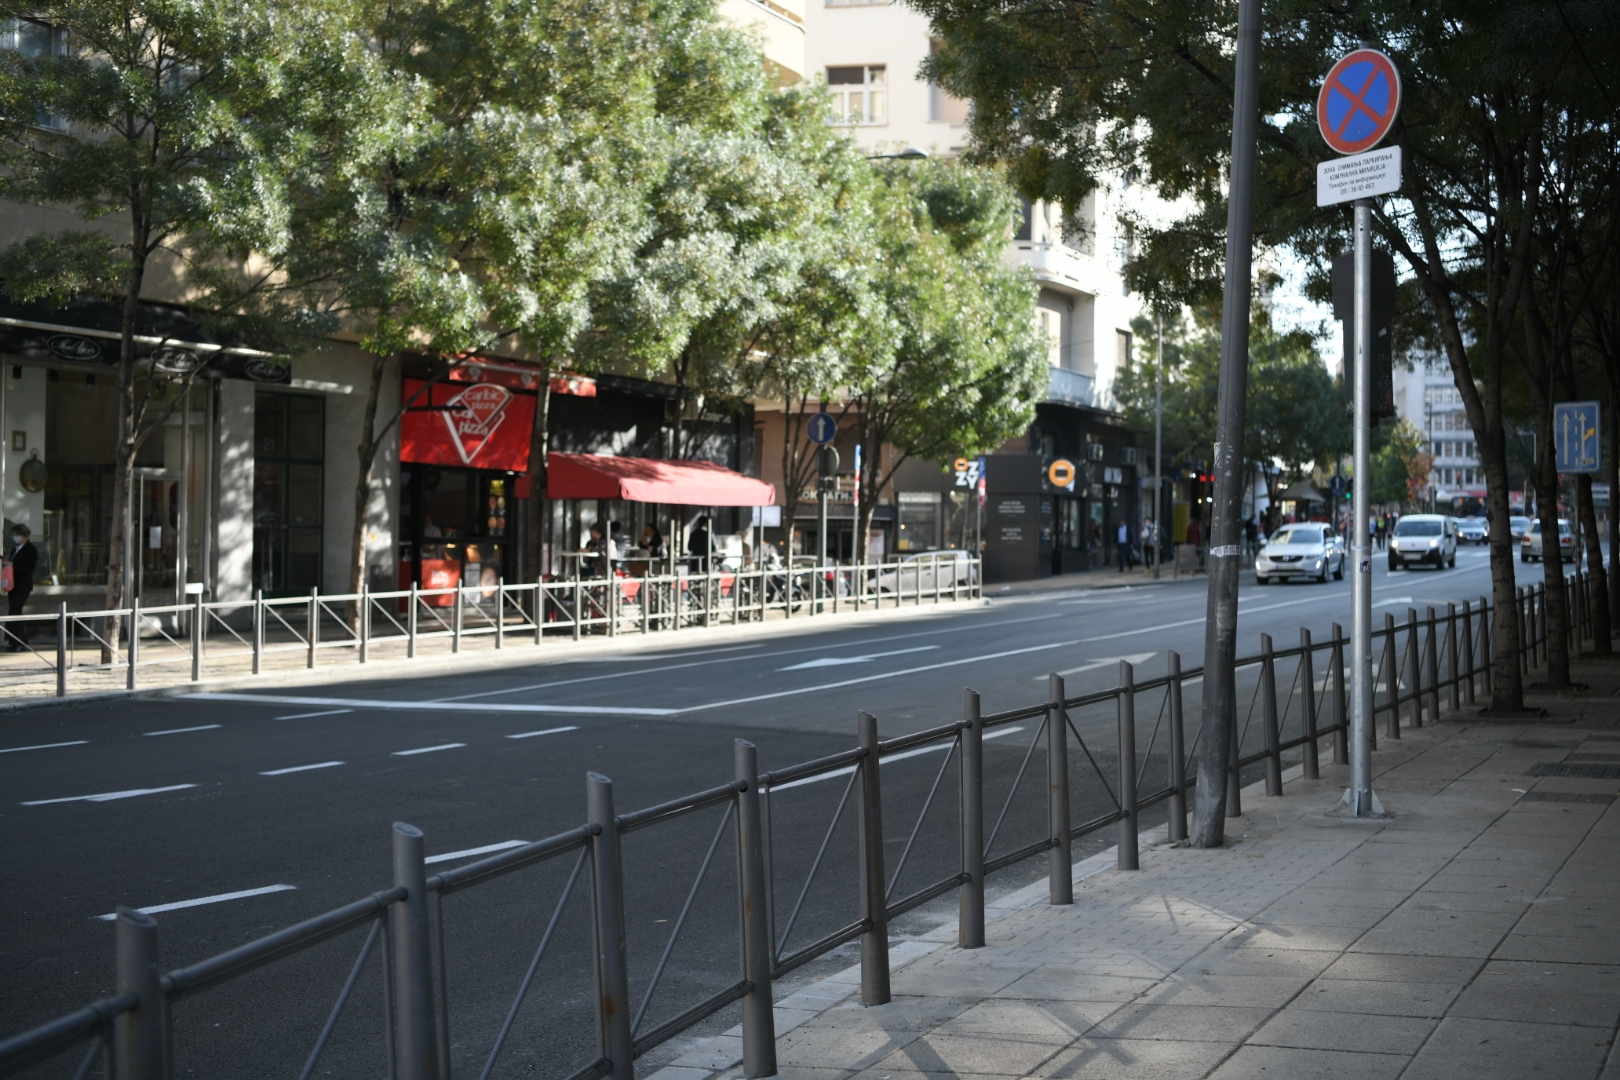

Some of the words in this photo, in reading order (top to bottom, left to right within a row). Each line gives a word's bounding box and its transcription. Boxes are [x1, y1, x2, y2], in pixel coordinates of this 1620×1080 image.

[1323, 166, 1336, 175] ЗОНА
[1362, 153, 1393, 167] ПАРКИРАЊА
[1329, 170, 1359, 182] КОМУНАЛНА
[1358, 164, 1386, 175] МИЛИЦИЈА
[1328, 180, 1349, 190] Телефон
[471, 401, 496, 410] pizza
[458, 421, 489, 436] pizza
